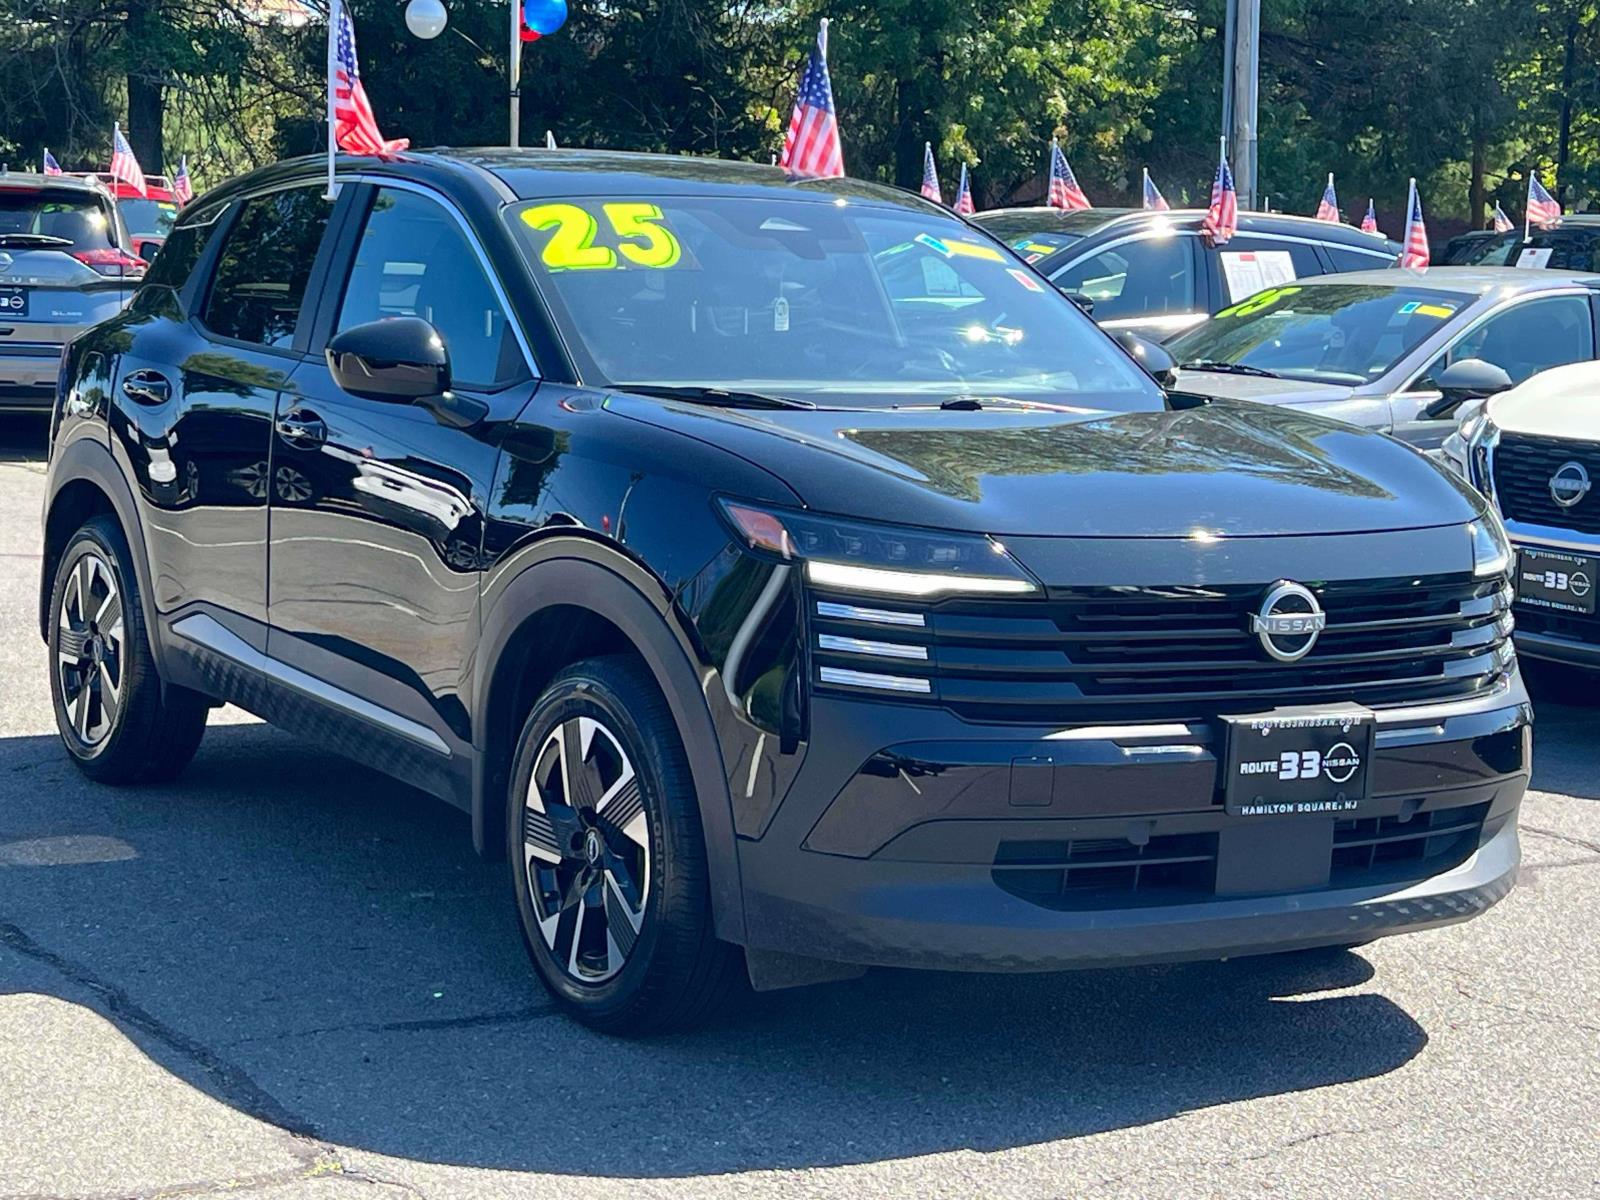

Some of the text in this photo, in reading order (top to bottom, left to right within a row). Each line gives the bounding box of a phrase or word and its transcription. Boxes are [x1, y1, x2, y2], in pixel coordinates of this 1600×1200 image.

[520, 203, 681, 269] 25
[1544, 570, 1568, 590] 33
[1256, 618, 1324, 631] NISSAN
[1240, 750, 1360, 780] ROUTE 33 NISSAN
[1241, 800, 1358, 815] HAMILTON SQUARE, NJ
